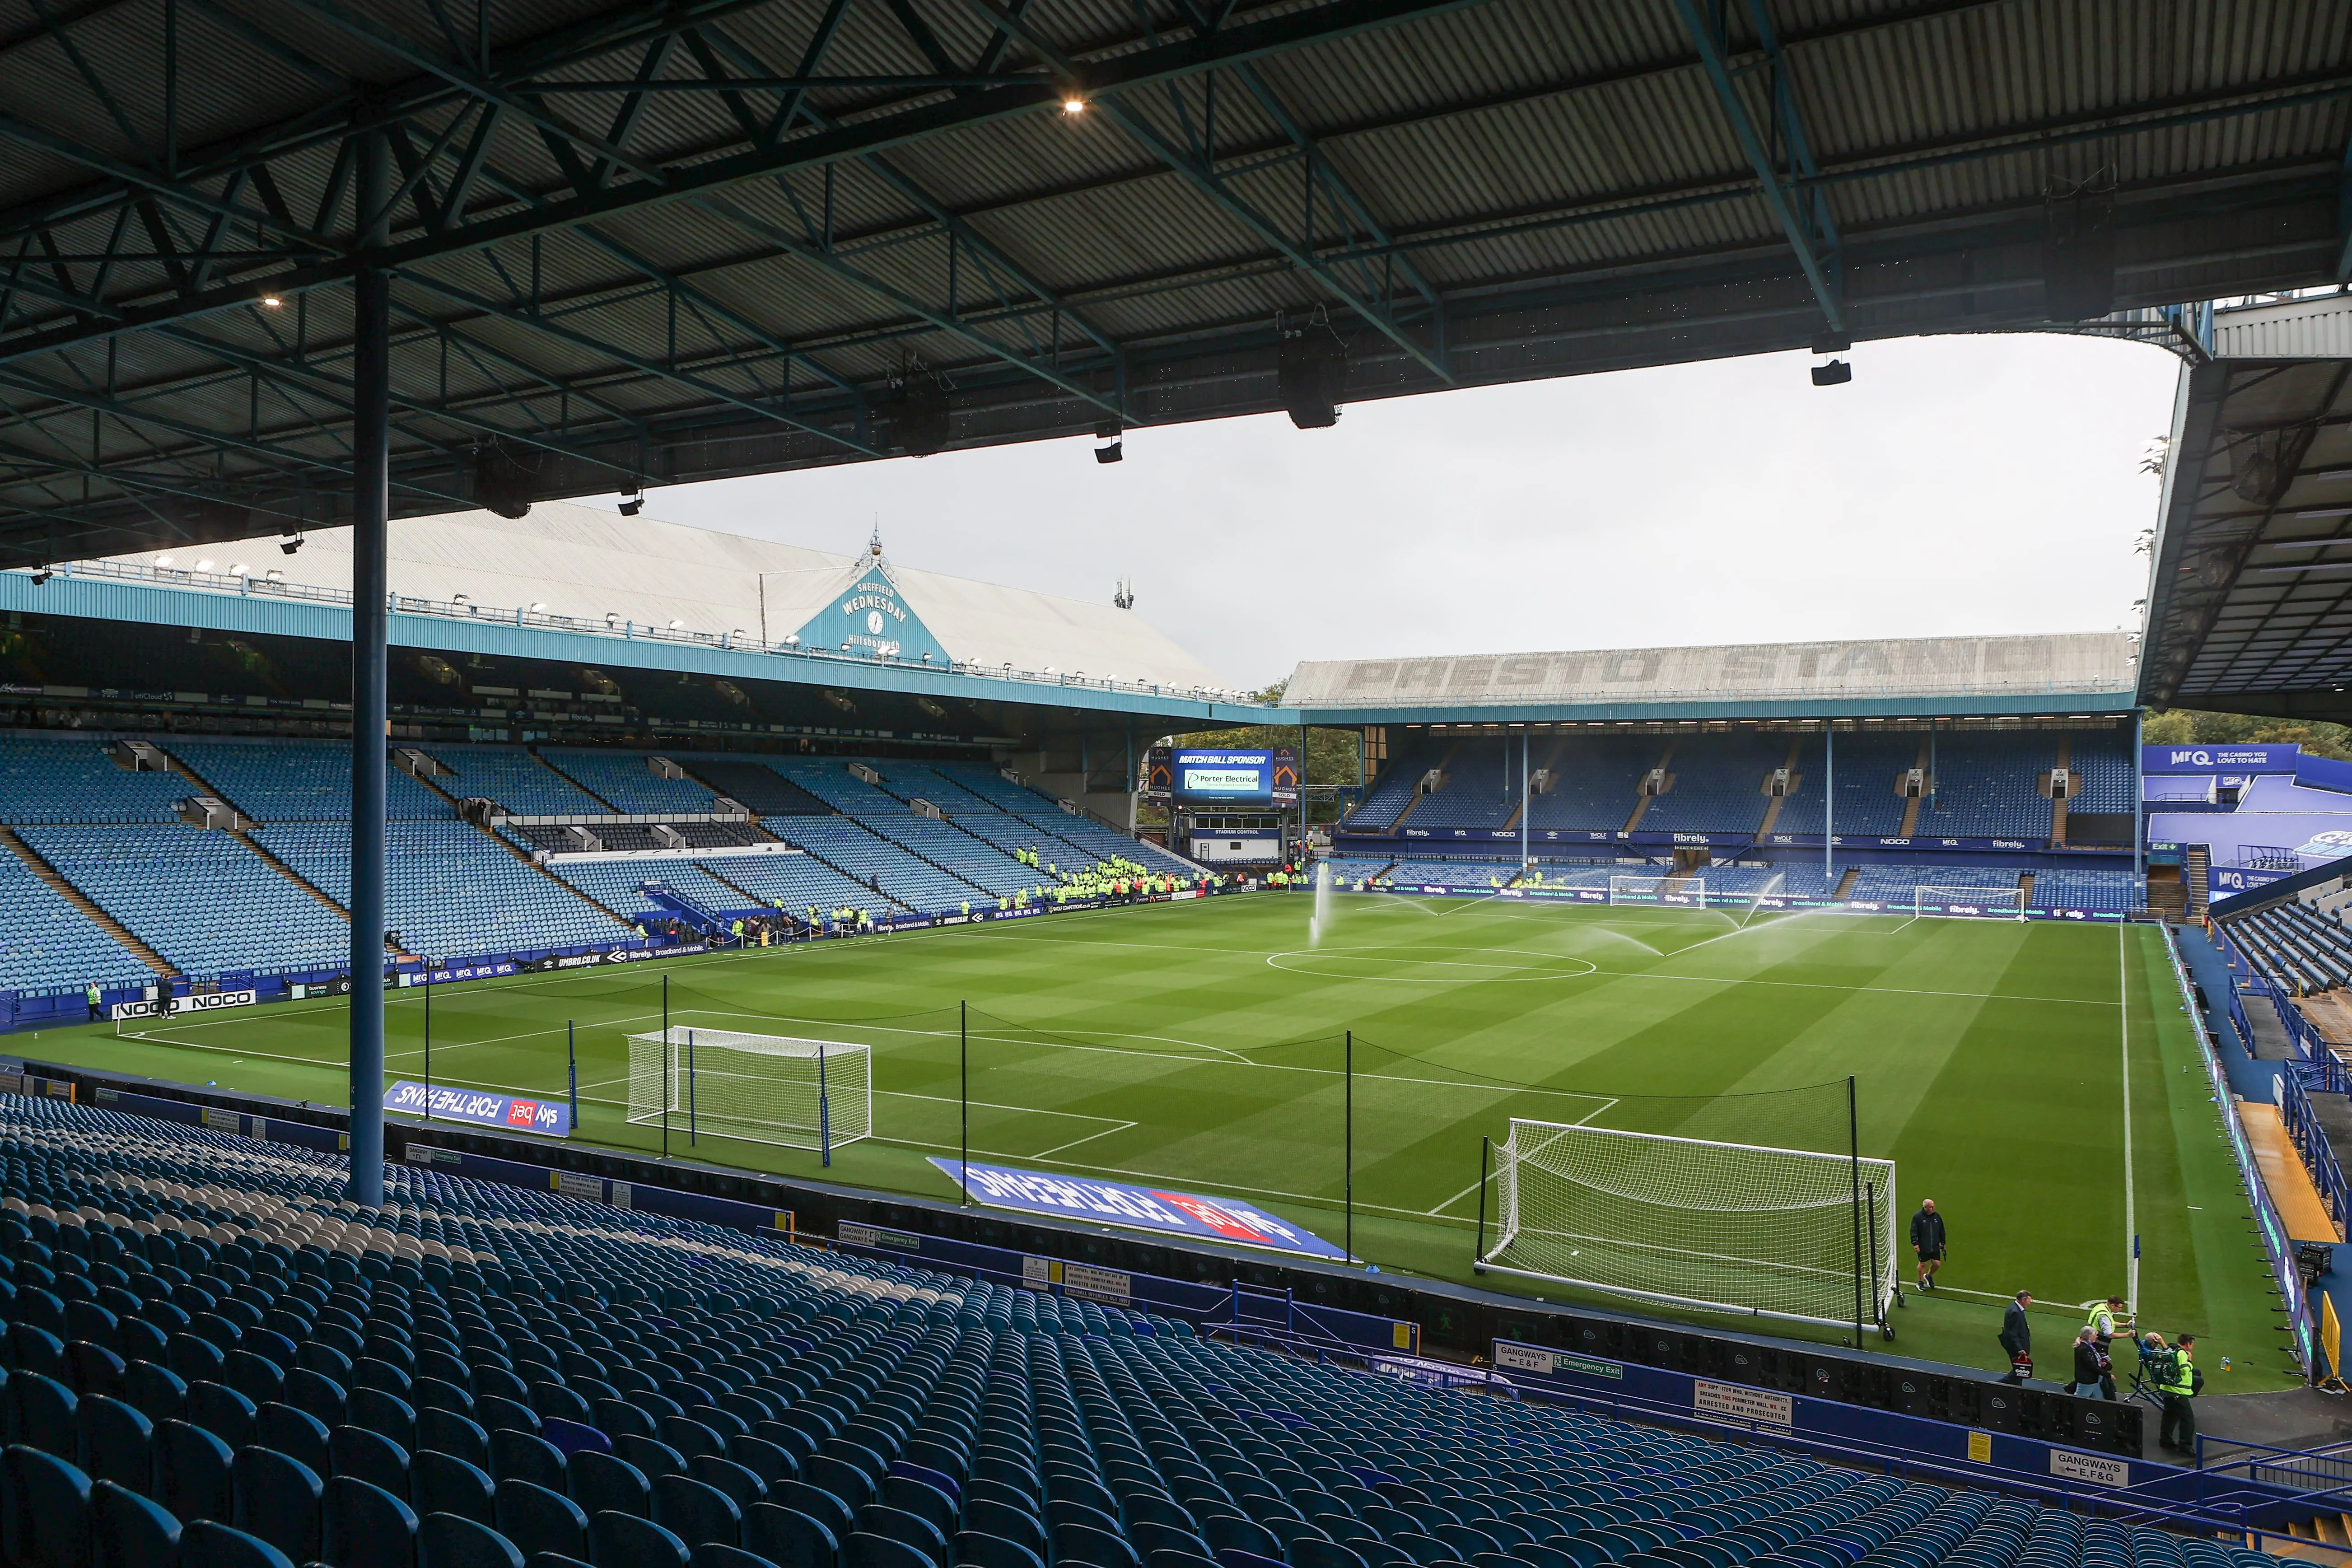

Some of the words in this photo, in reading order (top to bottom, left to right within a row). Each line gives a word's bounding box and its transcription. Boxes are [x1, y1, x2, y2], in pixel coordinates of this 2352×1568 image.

[857, 583, 894, 597] SHEFFIELD
[843, 595, 906, 623] WEDNESDAY
[849, 635, 900, 649] Hillsborough
[1345, 654, 1661, 689] PRESTO
[1179, 756, 1208, 764] MATCH
[1227, 756, 1265, 764] SPONSOR
[2171, 751, 2214, 765] MrQ
[2223, 777, 2244, 786] MrQ
[1673, 833, 1709, 844] fibrely.
[1993, 840, 2025, 848] fibrely.
[2219, 872, 2245, 889] MrQ
[1424, 886, 1447, 894] fibrely.
[1500, 889, 1523, 897] fibrely.
[1580, 891, 1605, 901] fibrely.
[1665, 895, 1690, 904] fibrely.
[1851, 901, 1880, 910] fibrely.
[1949, 905, 1979, 915] fibrely.
[2053, 909, 2086, 919] firely.
[944, 916, 968, 924] UMBRO.CO.UK
[630, 950, 653, 959] fibrely.
[655, 947, 682, 956] Broadband
[558, 954, 601, 967] UMBRO.CO.UK
[435, 971, 452, 981] MrQ
[456, 969, 472, 978] MrQ
[477, 966, 493, 976] MrQ
[497, 965, 513, 974] MrQ
[193, 992, 250, 1008] NOCO
[394, 1086, 439, 1106] FANS
[433, 1091, 468, 1113] THE
[466, 1096, 503, 1118] FOR
[511, 1104, 533, 1125] bet
[535, 1105, 558, 1128] sky
[840, 1226, 864, 1235] GANGWAY
[840, 1232, 864, 1241] GANGWAY
[882, 1233, 907, 1244] Emergency
[1501, 1346, 1546, 1361] GANGWAYS
[1519, 1358, 1525, 1366] E
[1526, 1359, 1532, 1367] &
[1563, 1358, 1604, 1372] Emergency
[1605, 1364, 1620, 1374] Exit
[1700, 1391, 1721, 1399] BREACHES
[1732, 1397, 1755, 1405] PERIMETER
[1699, 1399, 1729, 1409] ARRESTED
[1747, 1408, 1788, 1421] PROSECUTED.
[2058, 1454, 2120, 1473] GANGWAYS
